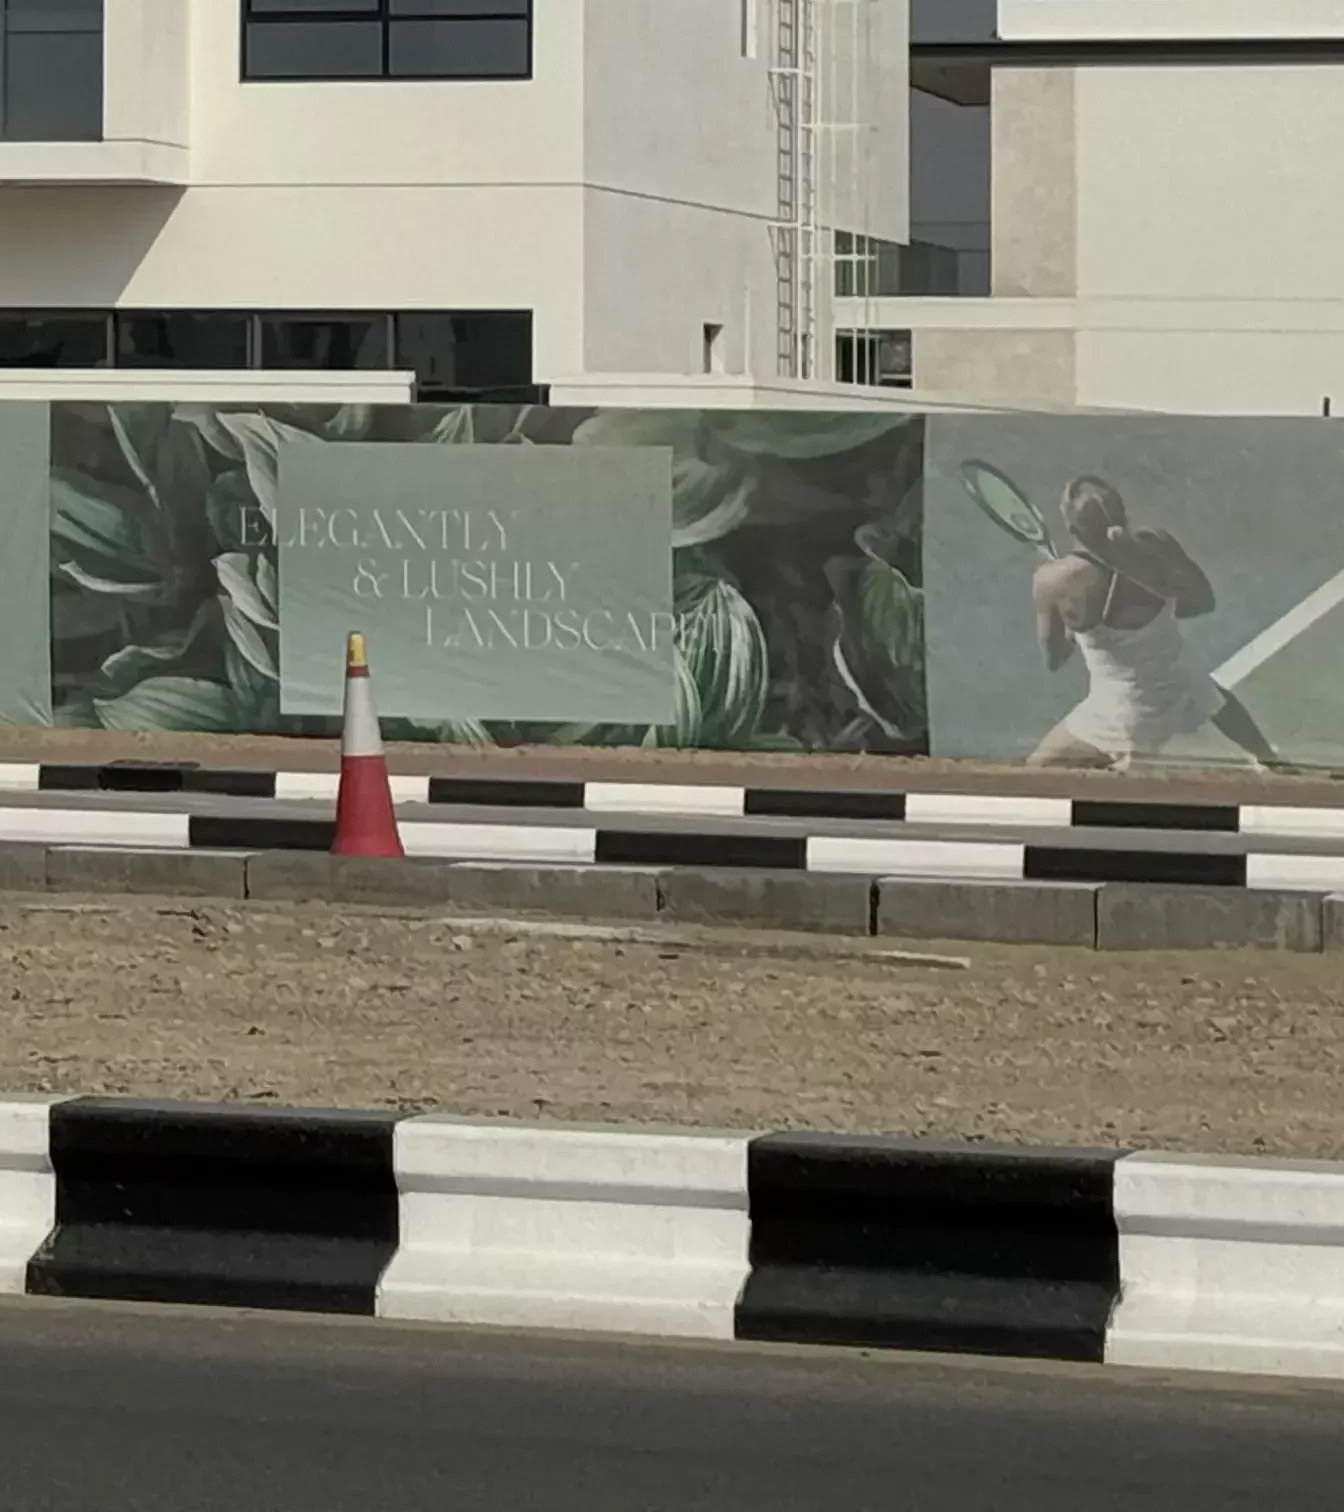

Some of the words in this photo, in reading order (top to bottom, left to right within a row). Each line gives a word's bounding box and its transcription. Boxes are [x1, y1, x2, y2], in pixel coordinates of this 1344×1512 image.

[239, 506, 518, 551] ELEGANTLY
[353, 557, 390, 599] &
[400, 558, 580, 601] LUSHLY
